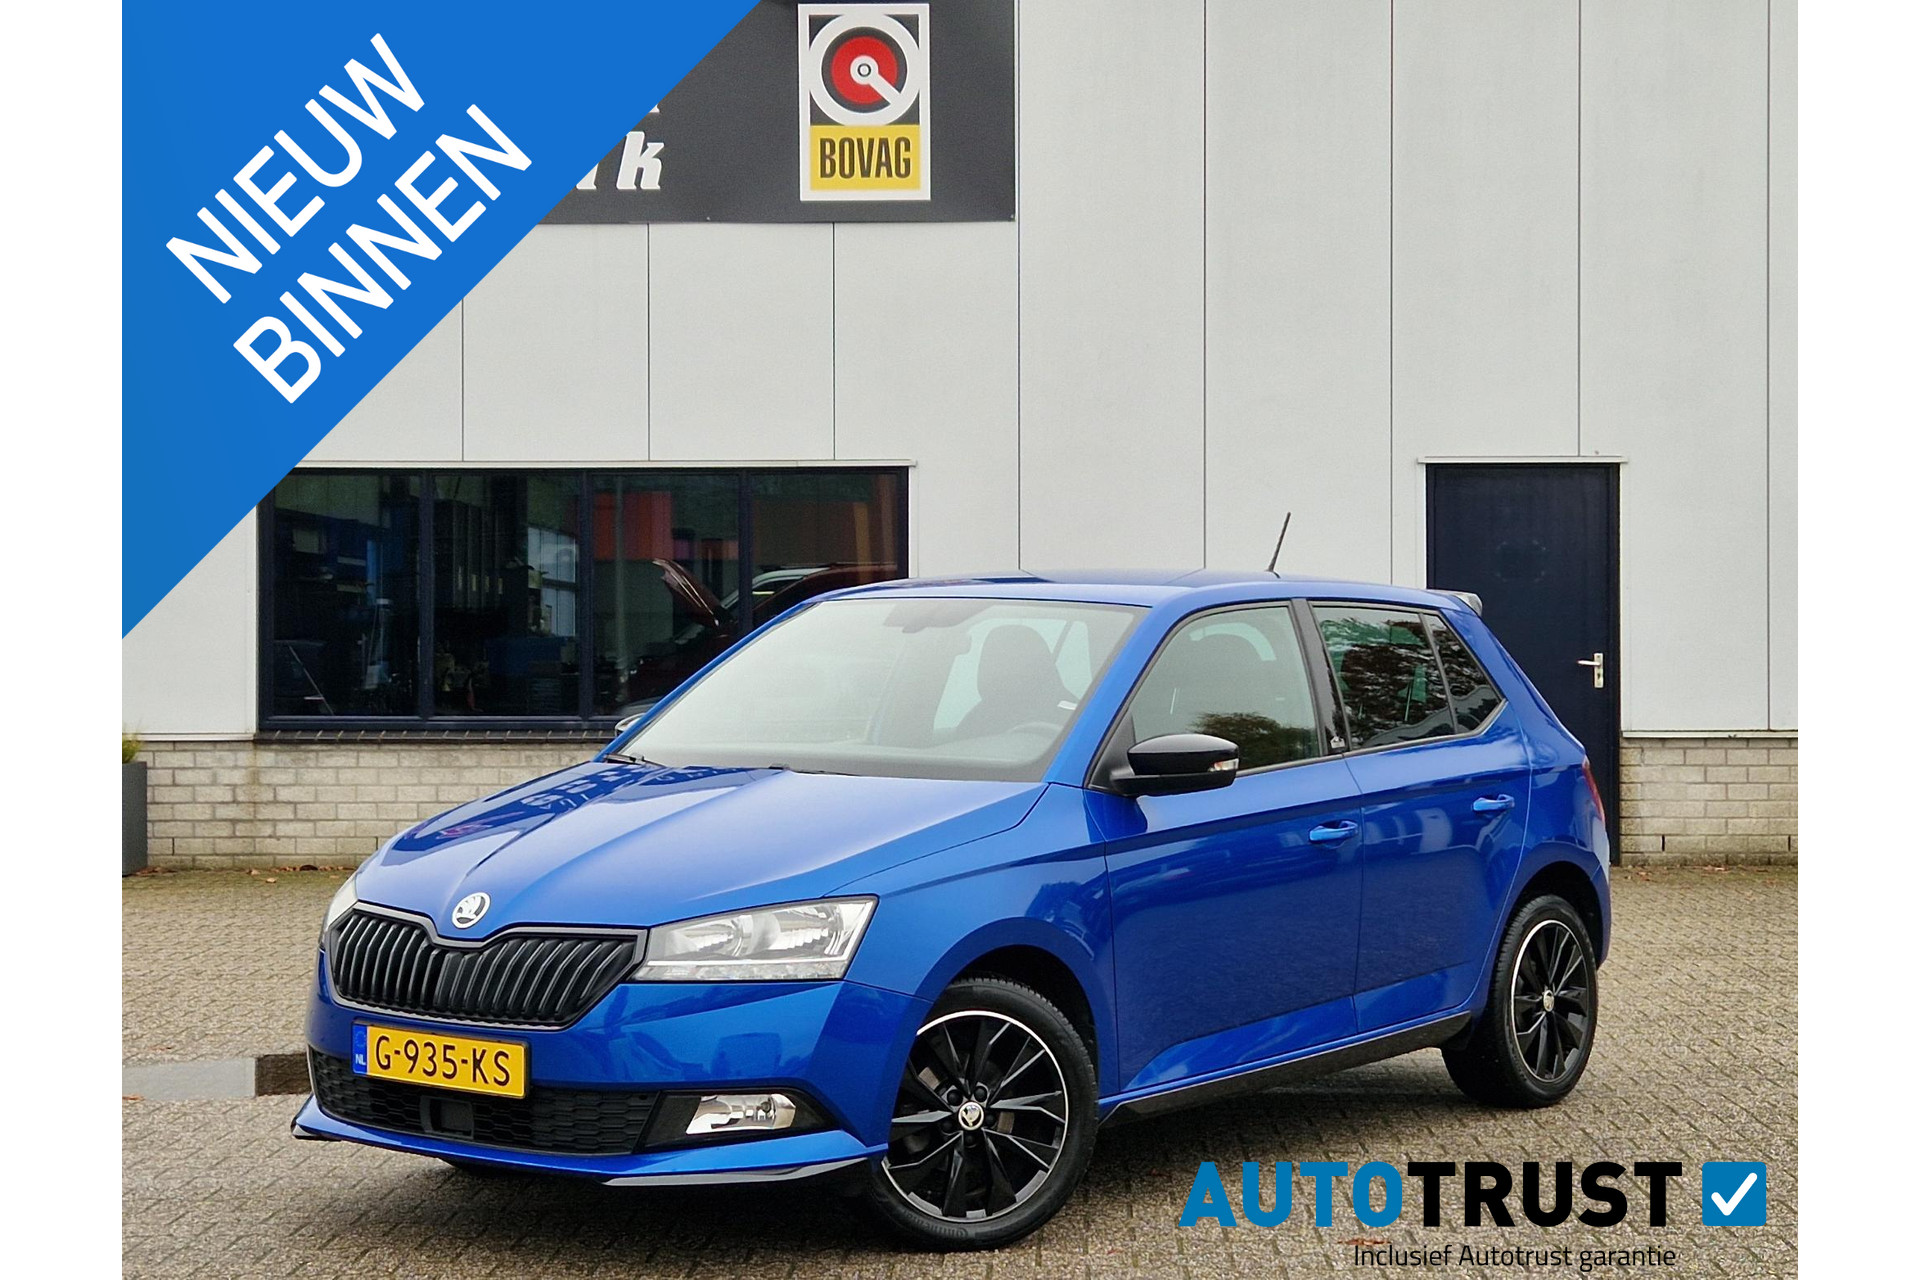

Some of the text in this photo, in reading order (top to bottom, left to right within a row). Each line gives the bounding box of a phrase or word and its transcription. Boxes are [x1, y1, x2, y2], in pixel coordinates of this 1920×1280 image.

[819, 136, 912, 179] BOVAG
[355, 1053, 367, 1065] NL
[375, 1035, 511, 1087] G-935-KS
